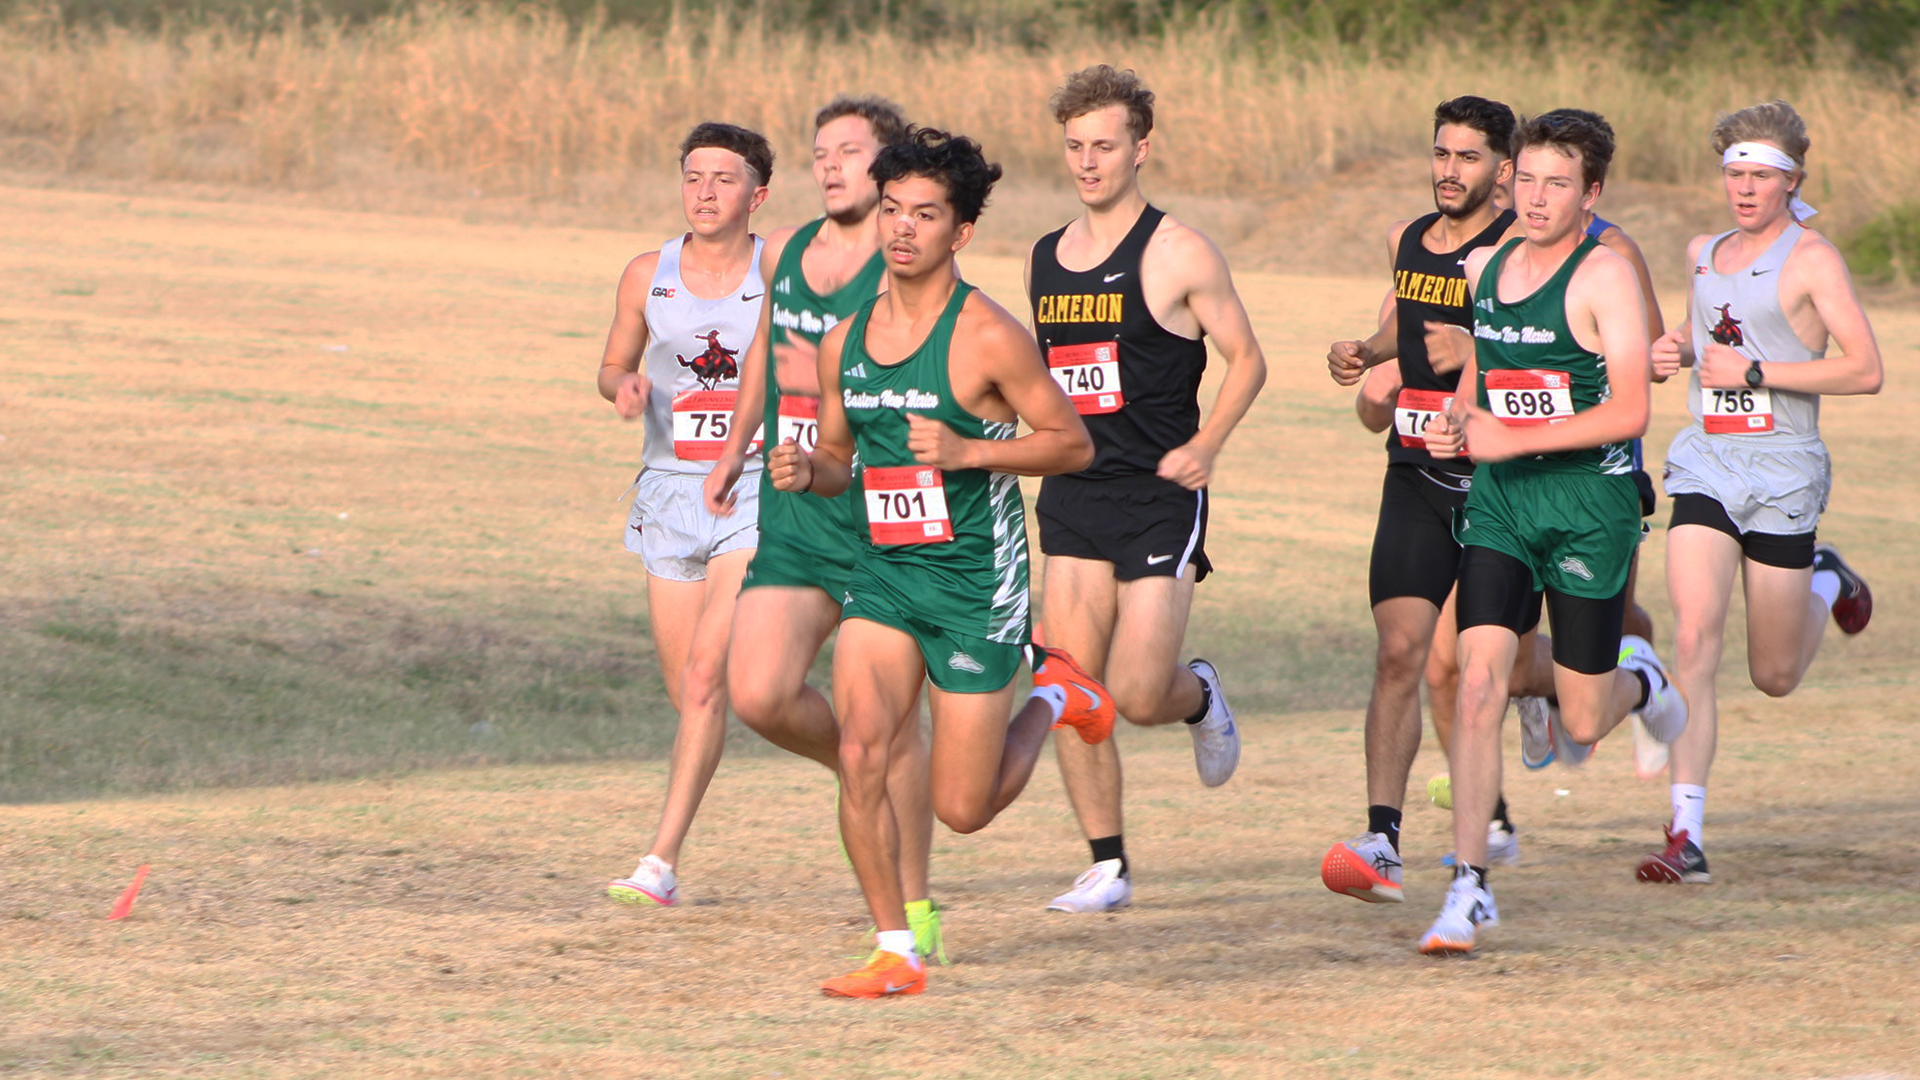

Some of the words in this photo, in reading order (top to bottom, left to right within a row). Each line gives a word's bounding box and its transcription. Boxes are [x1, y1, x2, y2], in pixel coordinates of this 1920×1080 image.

[651, 286, 676, 298] GAC
[1037, 293, 1124, 324] CAMERON
[1502, 325, 1520, 344] New
[1521, 325, 1557, 344] Mexico
[1062, 365, 1105, 394] 740
[844, 387, 880, 409] Eastern
[880, 388, 905, 409] New
[905, 388, 939, 409] Mexico
[1504, 391, 1555, 416] 698
[1712, 389, 1755, 413] 756
[690, 413, 728, 438] 75
[792, 421, 818, 448] 70
[1407, 411, 1432, 435] 74
[878, 491, 927, 520] 701
